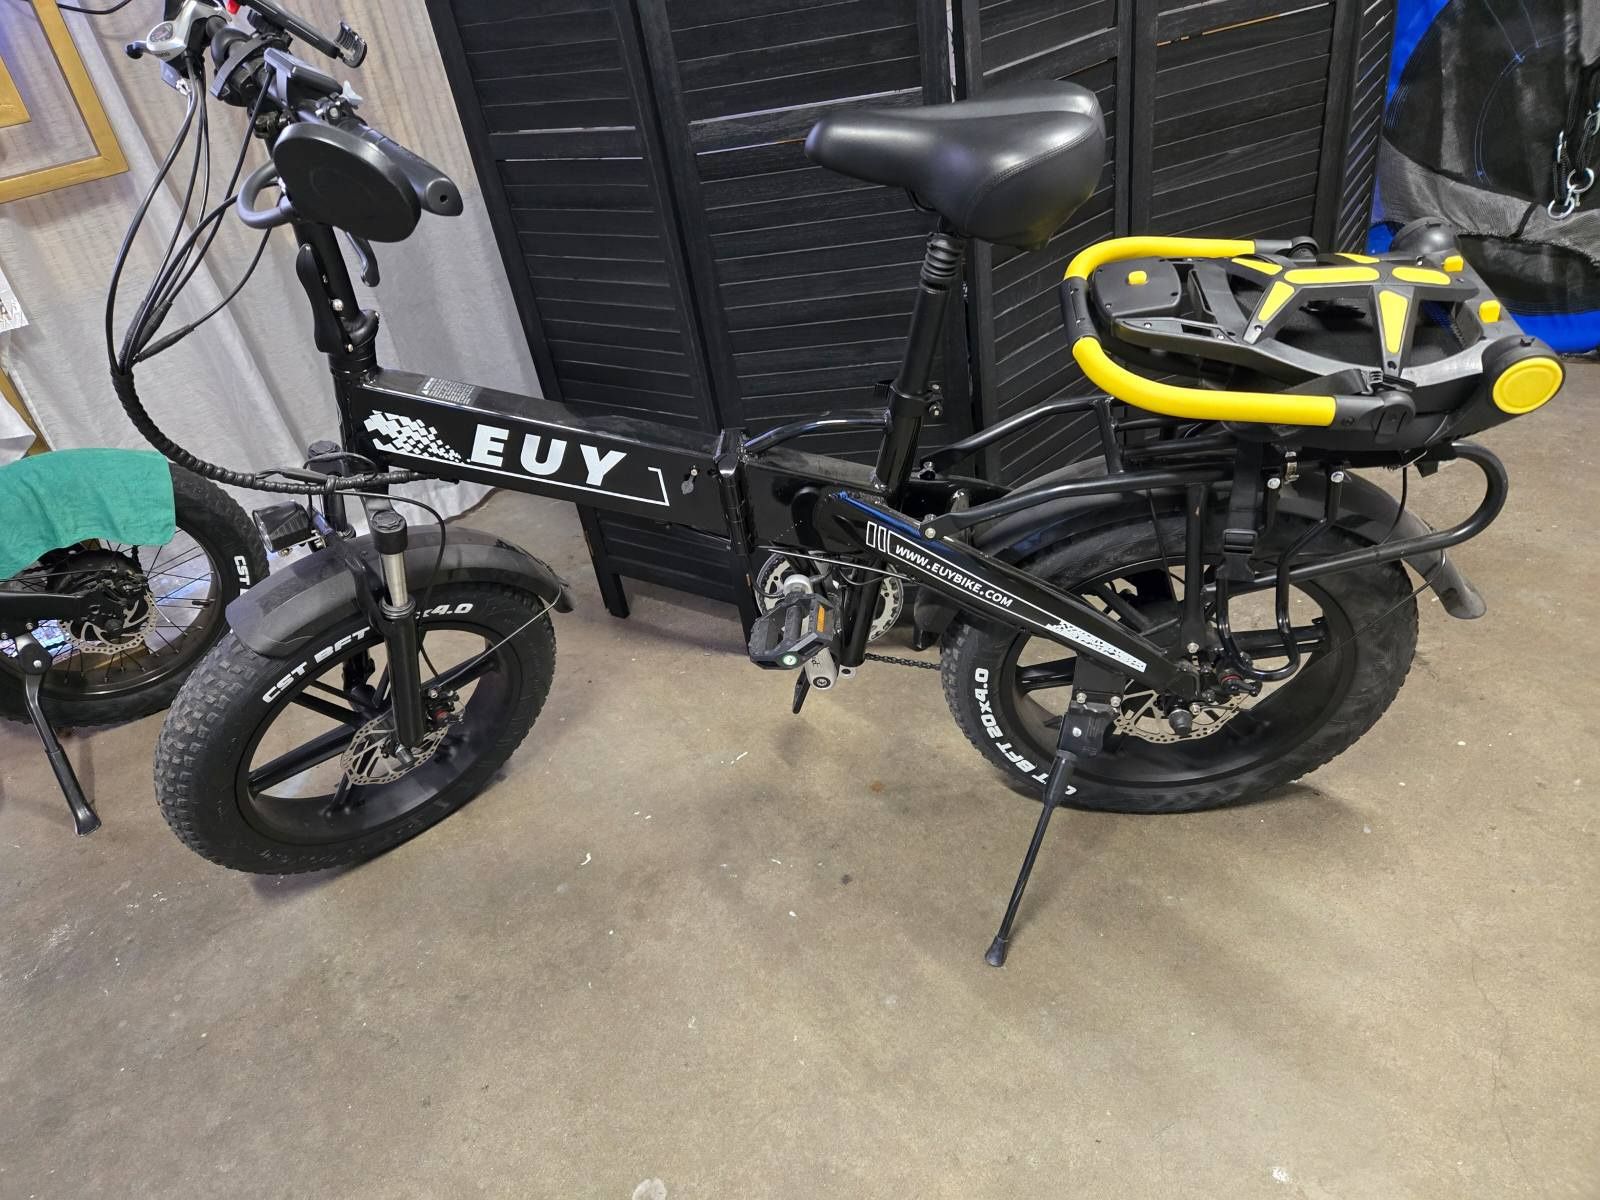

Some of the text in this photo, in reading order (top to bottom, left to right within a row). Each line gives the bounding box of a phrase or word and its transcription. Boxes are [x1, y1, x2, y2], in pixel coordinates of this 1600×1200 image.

[470, 423, 627, 487] EUY
[233, 555, 251, 586] CST
[894, 543, 1014, 609] WWW.EUYBIKE.COM
[262, 661, 308, 704] CST
[313, 626, 371, 664] BFT
[995, 741, 1037, 773] BFT
